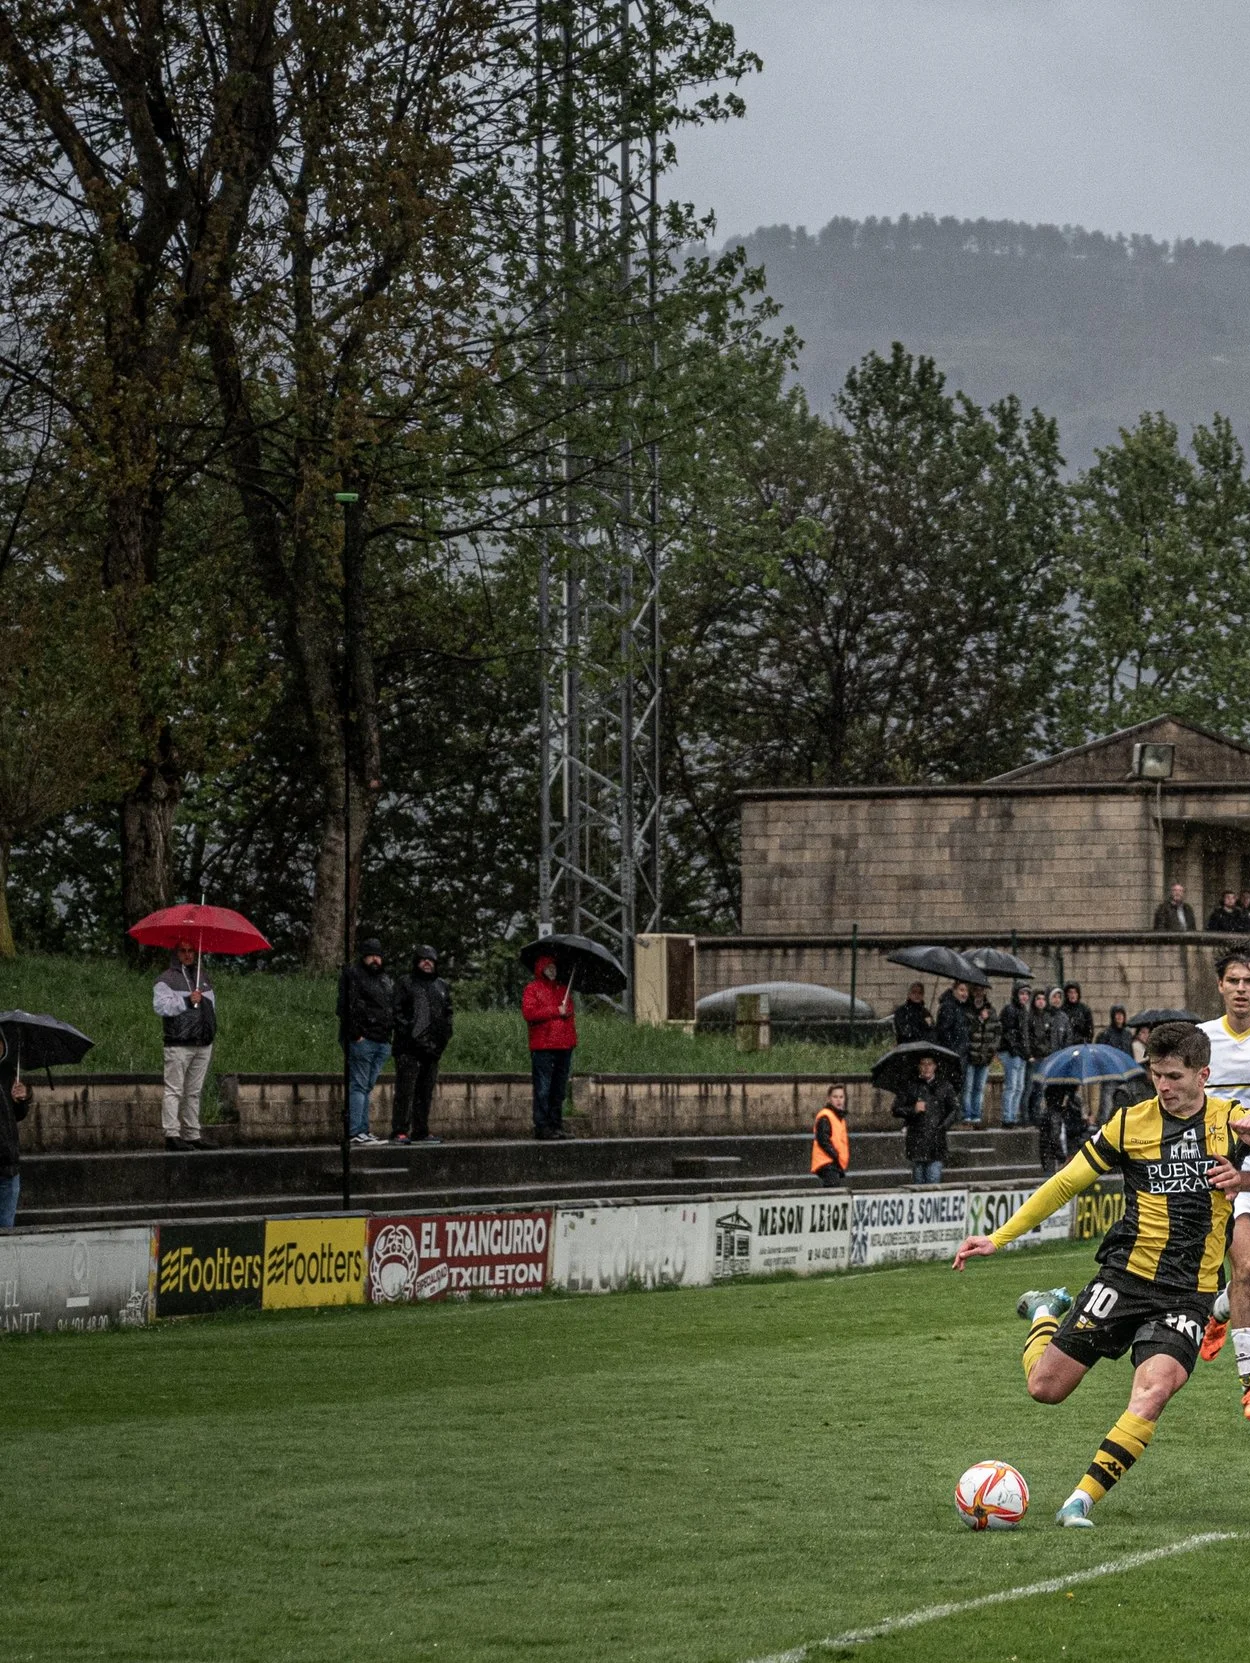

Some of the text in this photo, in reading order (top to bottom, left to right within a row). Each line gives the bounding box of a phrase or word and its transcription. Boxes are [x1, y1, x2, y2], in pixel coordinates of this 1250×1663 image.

[758, 1205, 804, 1236] MESON
[907, 1198, 915, 1225] &
[918, 1195, 965, 1224] SONELEC
[420, 1217, 547, 1259] EL TXANGURRO
[179, 1246, 262, 1293] Footters
[285, 1242, 362, 1286] Footters
[450, 1263, 544, 1288] TXULETON
[1083, 1282, 1119, 1319] 10
